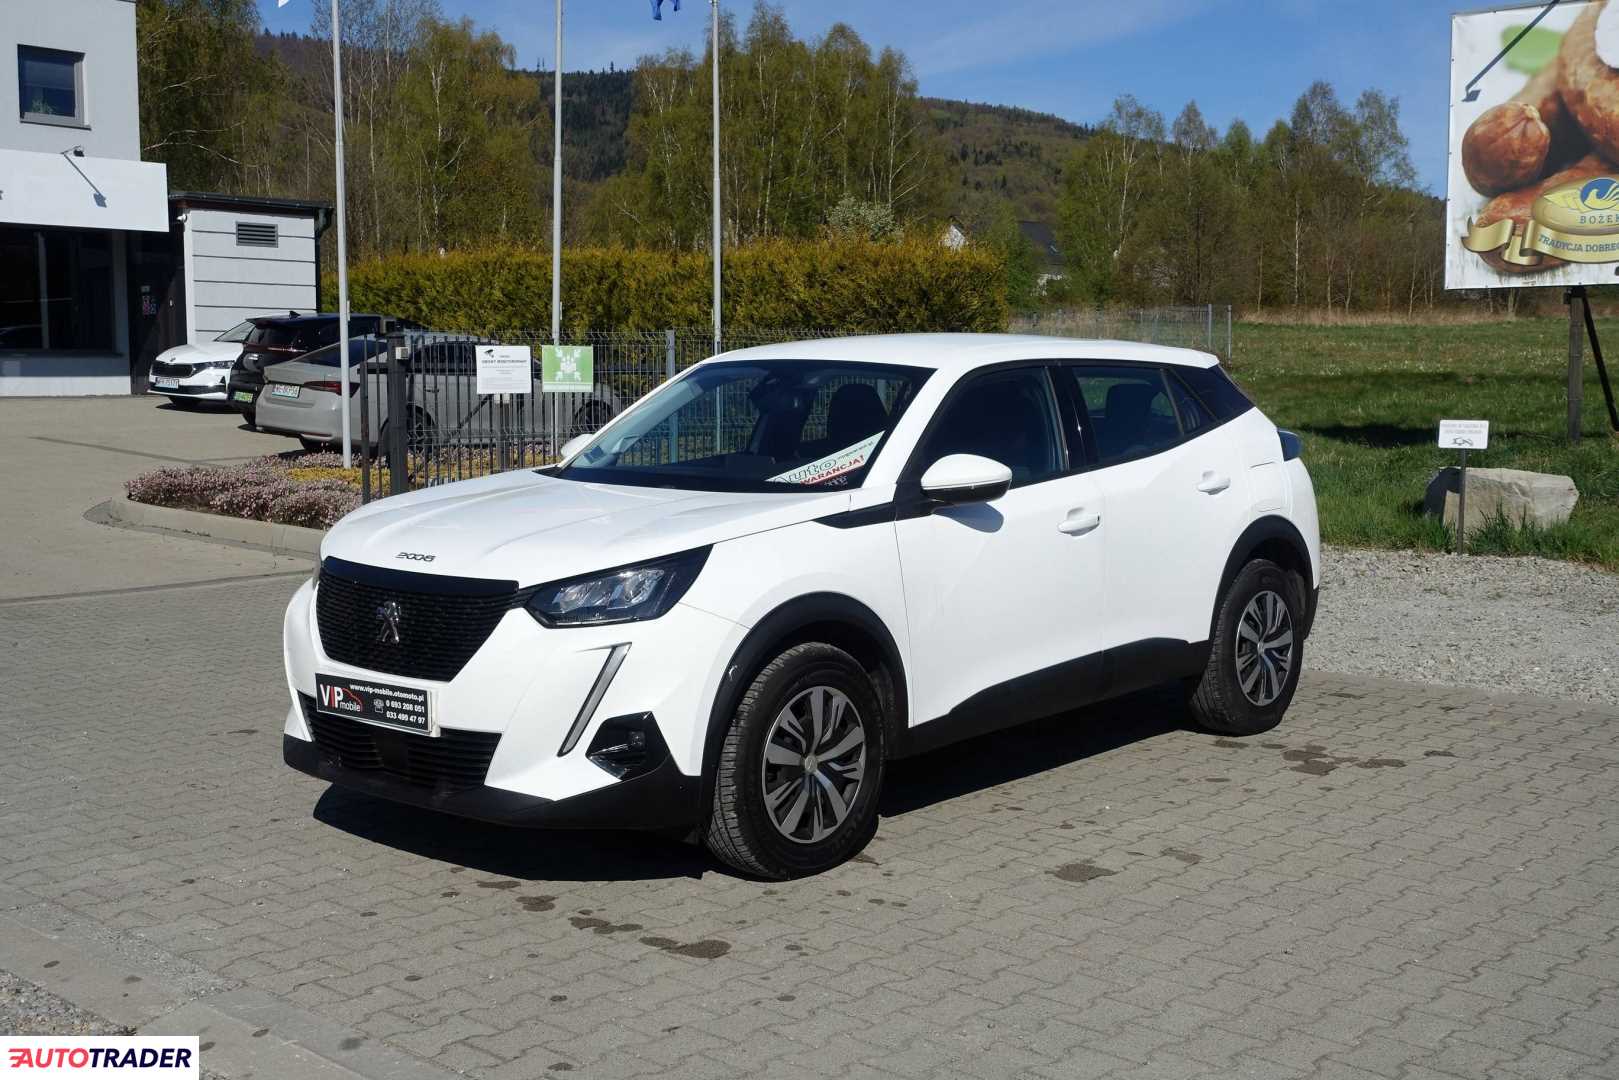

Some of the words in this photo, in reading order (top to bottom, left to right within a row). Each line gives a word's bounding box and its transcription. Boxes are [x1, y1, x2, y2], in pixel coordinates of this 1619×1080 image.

[1540, 234, 1583, 252] TRADYCJA
[320, 684, 343, 708] VIP
[349, 684, 425, 702] www.vip-mobile.otomoto.pl
[340, 701, 361, 712] mobile
